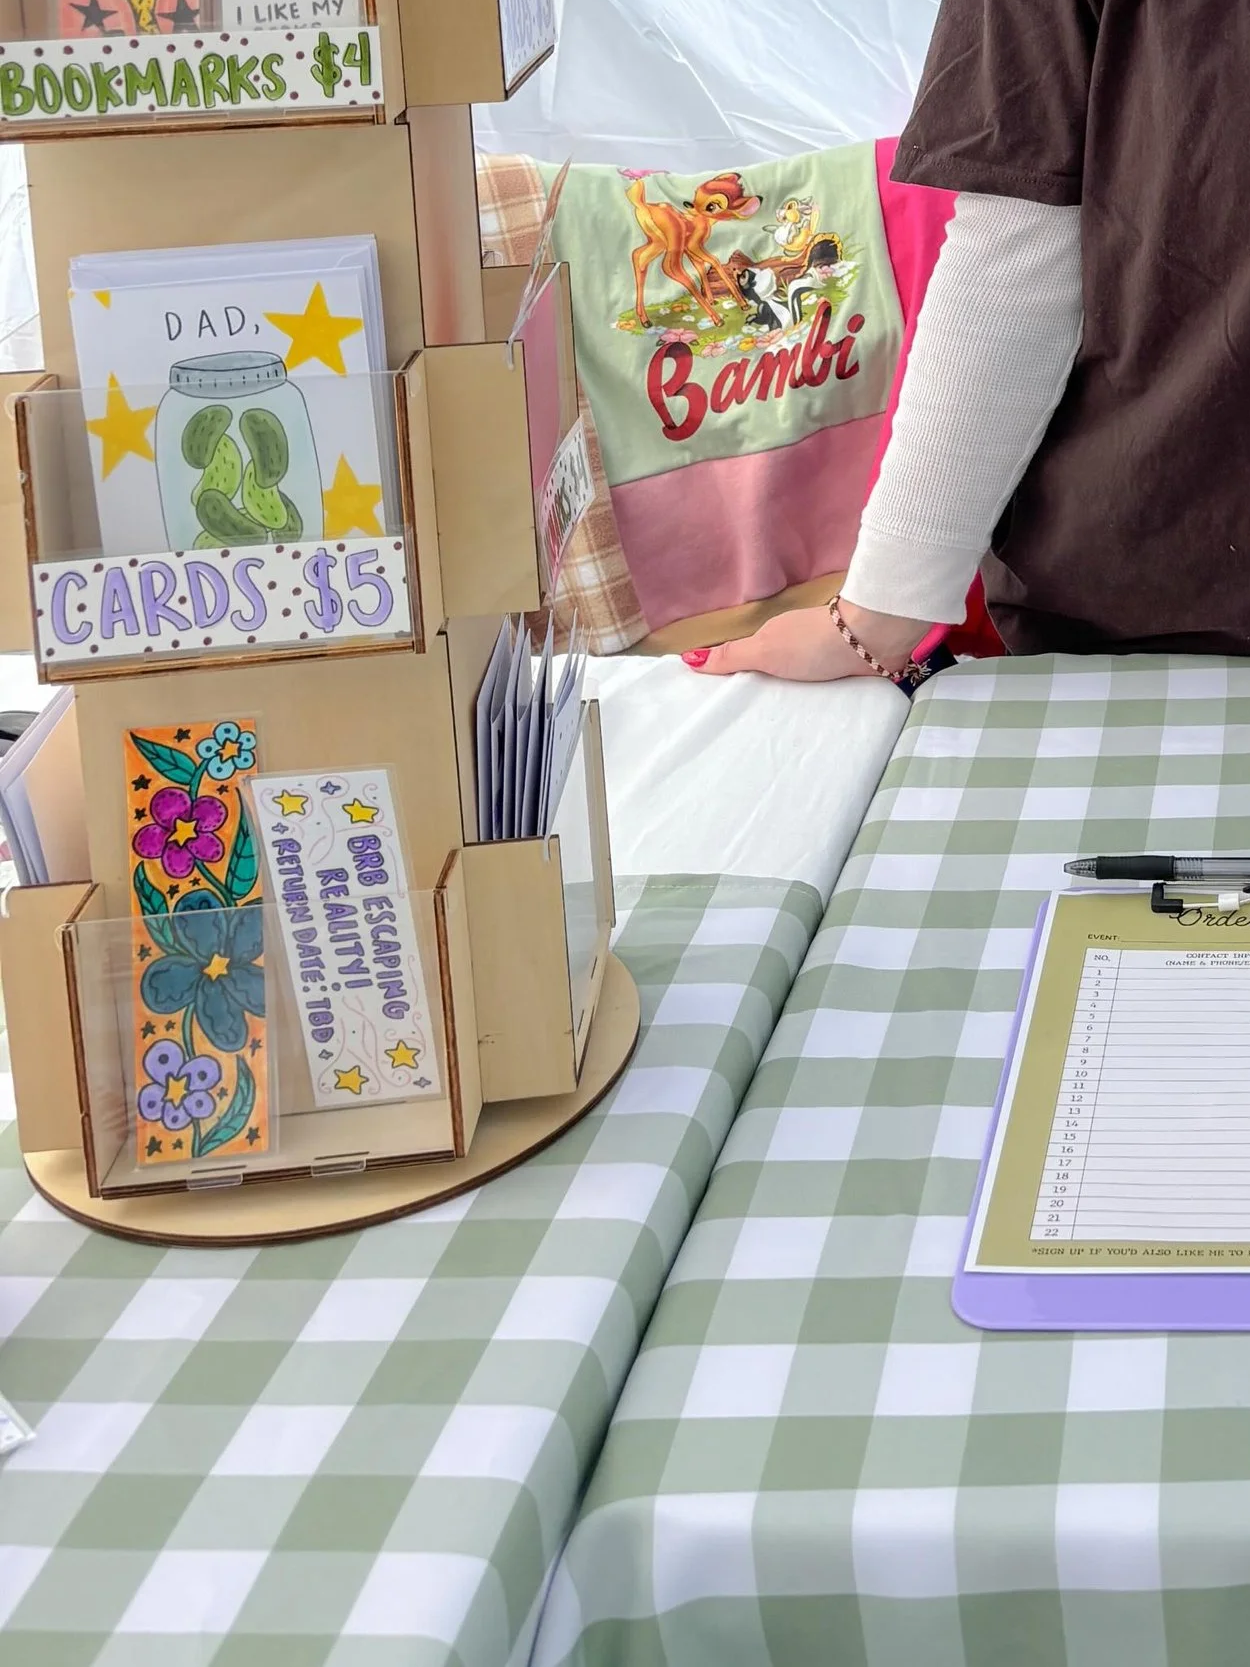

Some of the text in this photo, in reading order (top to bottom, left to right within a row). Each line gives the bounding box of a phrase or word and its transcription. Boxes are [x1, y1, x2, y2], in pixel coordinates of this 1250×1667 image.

[236, 6, 242, 26] I
[253, 2, 300, 24] LIKE
[0, 31, 372, 116] BOOKMARKS $4
[164, 305, 260, 341] DAD,
[646, 300, 866, 442] Bambi
[50, 547, 395, 645] CARDS $5
[316, 867, 373, 992] REALITY!
[347, 834, 410, 1020] BRB ESCAPING
[272, 837, 335, 1043] RETURN DATE: TBD
[1085, 1035, 1091, 1043] 7
[1082, 1046, 1089, 1054] 8
[1080, 1058, 1087, 1066] 9
[1070, 1094, 1083, 1102] 12
[1068, 1107, 1081, 1115] 13
[1055, 1172, 1069, 1180] 18
[1052, 1186, 1066, 1194] 19
[1049, 1199, 1064, 1208] 20
[1047, 1214, 1060, 1222] 21
[1044, 1228, 1059, 1237] 22
